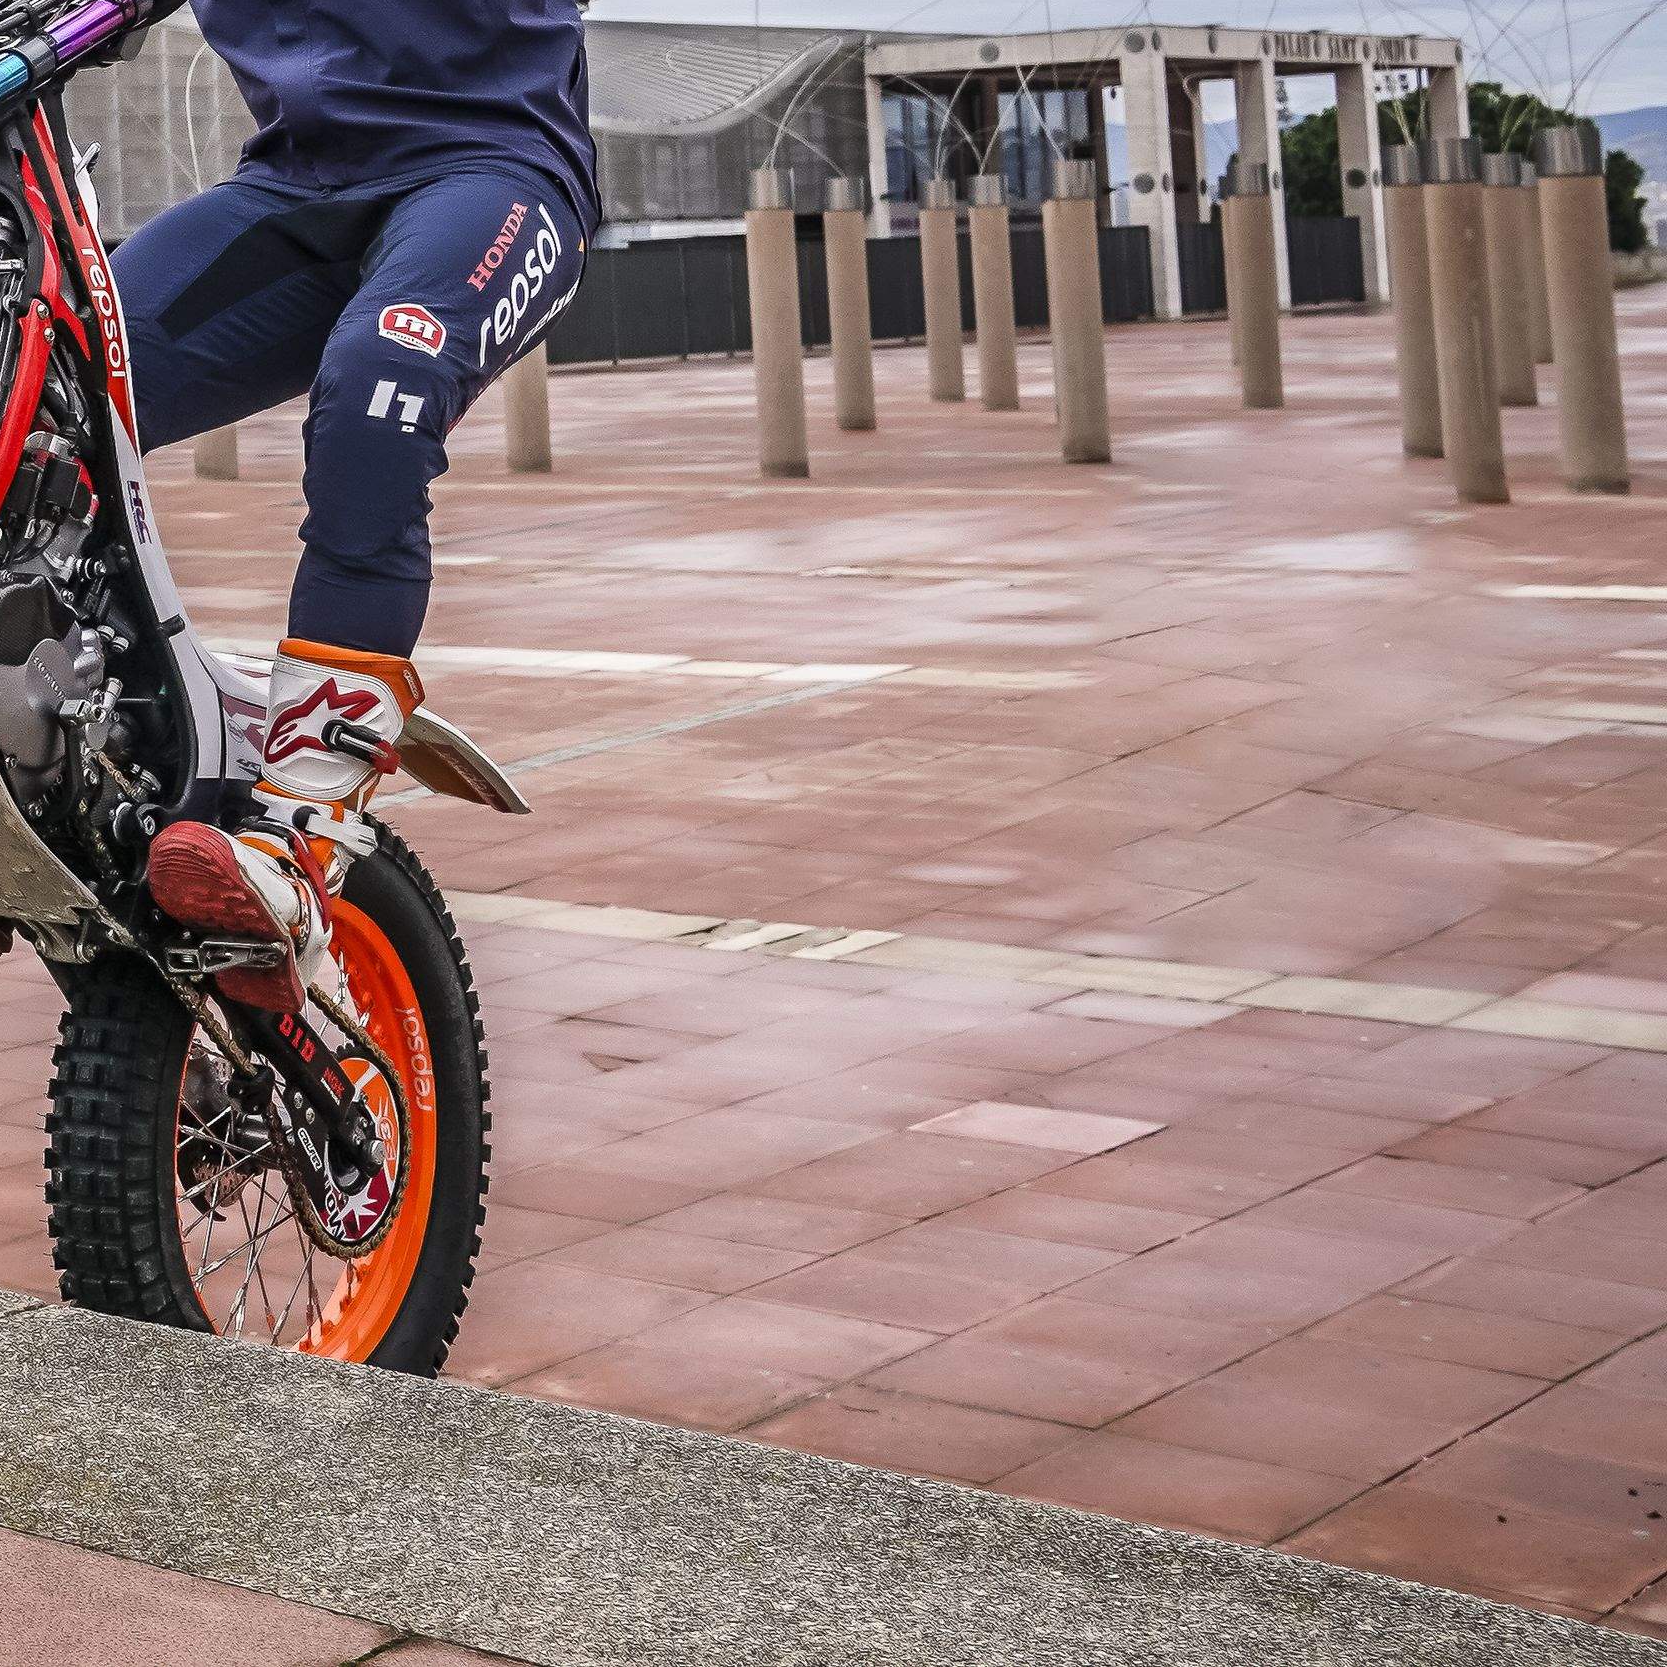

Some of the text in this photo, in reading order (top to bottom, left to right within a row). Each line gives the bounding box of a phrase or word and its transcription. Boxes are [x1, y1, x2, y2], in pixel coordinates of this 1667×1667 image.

[466, 201, 530, 293] HONDA
[478, 202, 563, 369] repsol
[79, 245, 128, 379] repsol
[394, 1006, 434, 1113] repsol
